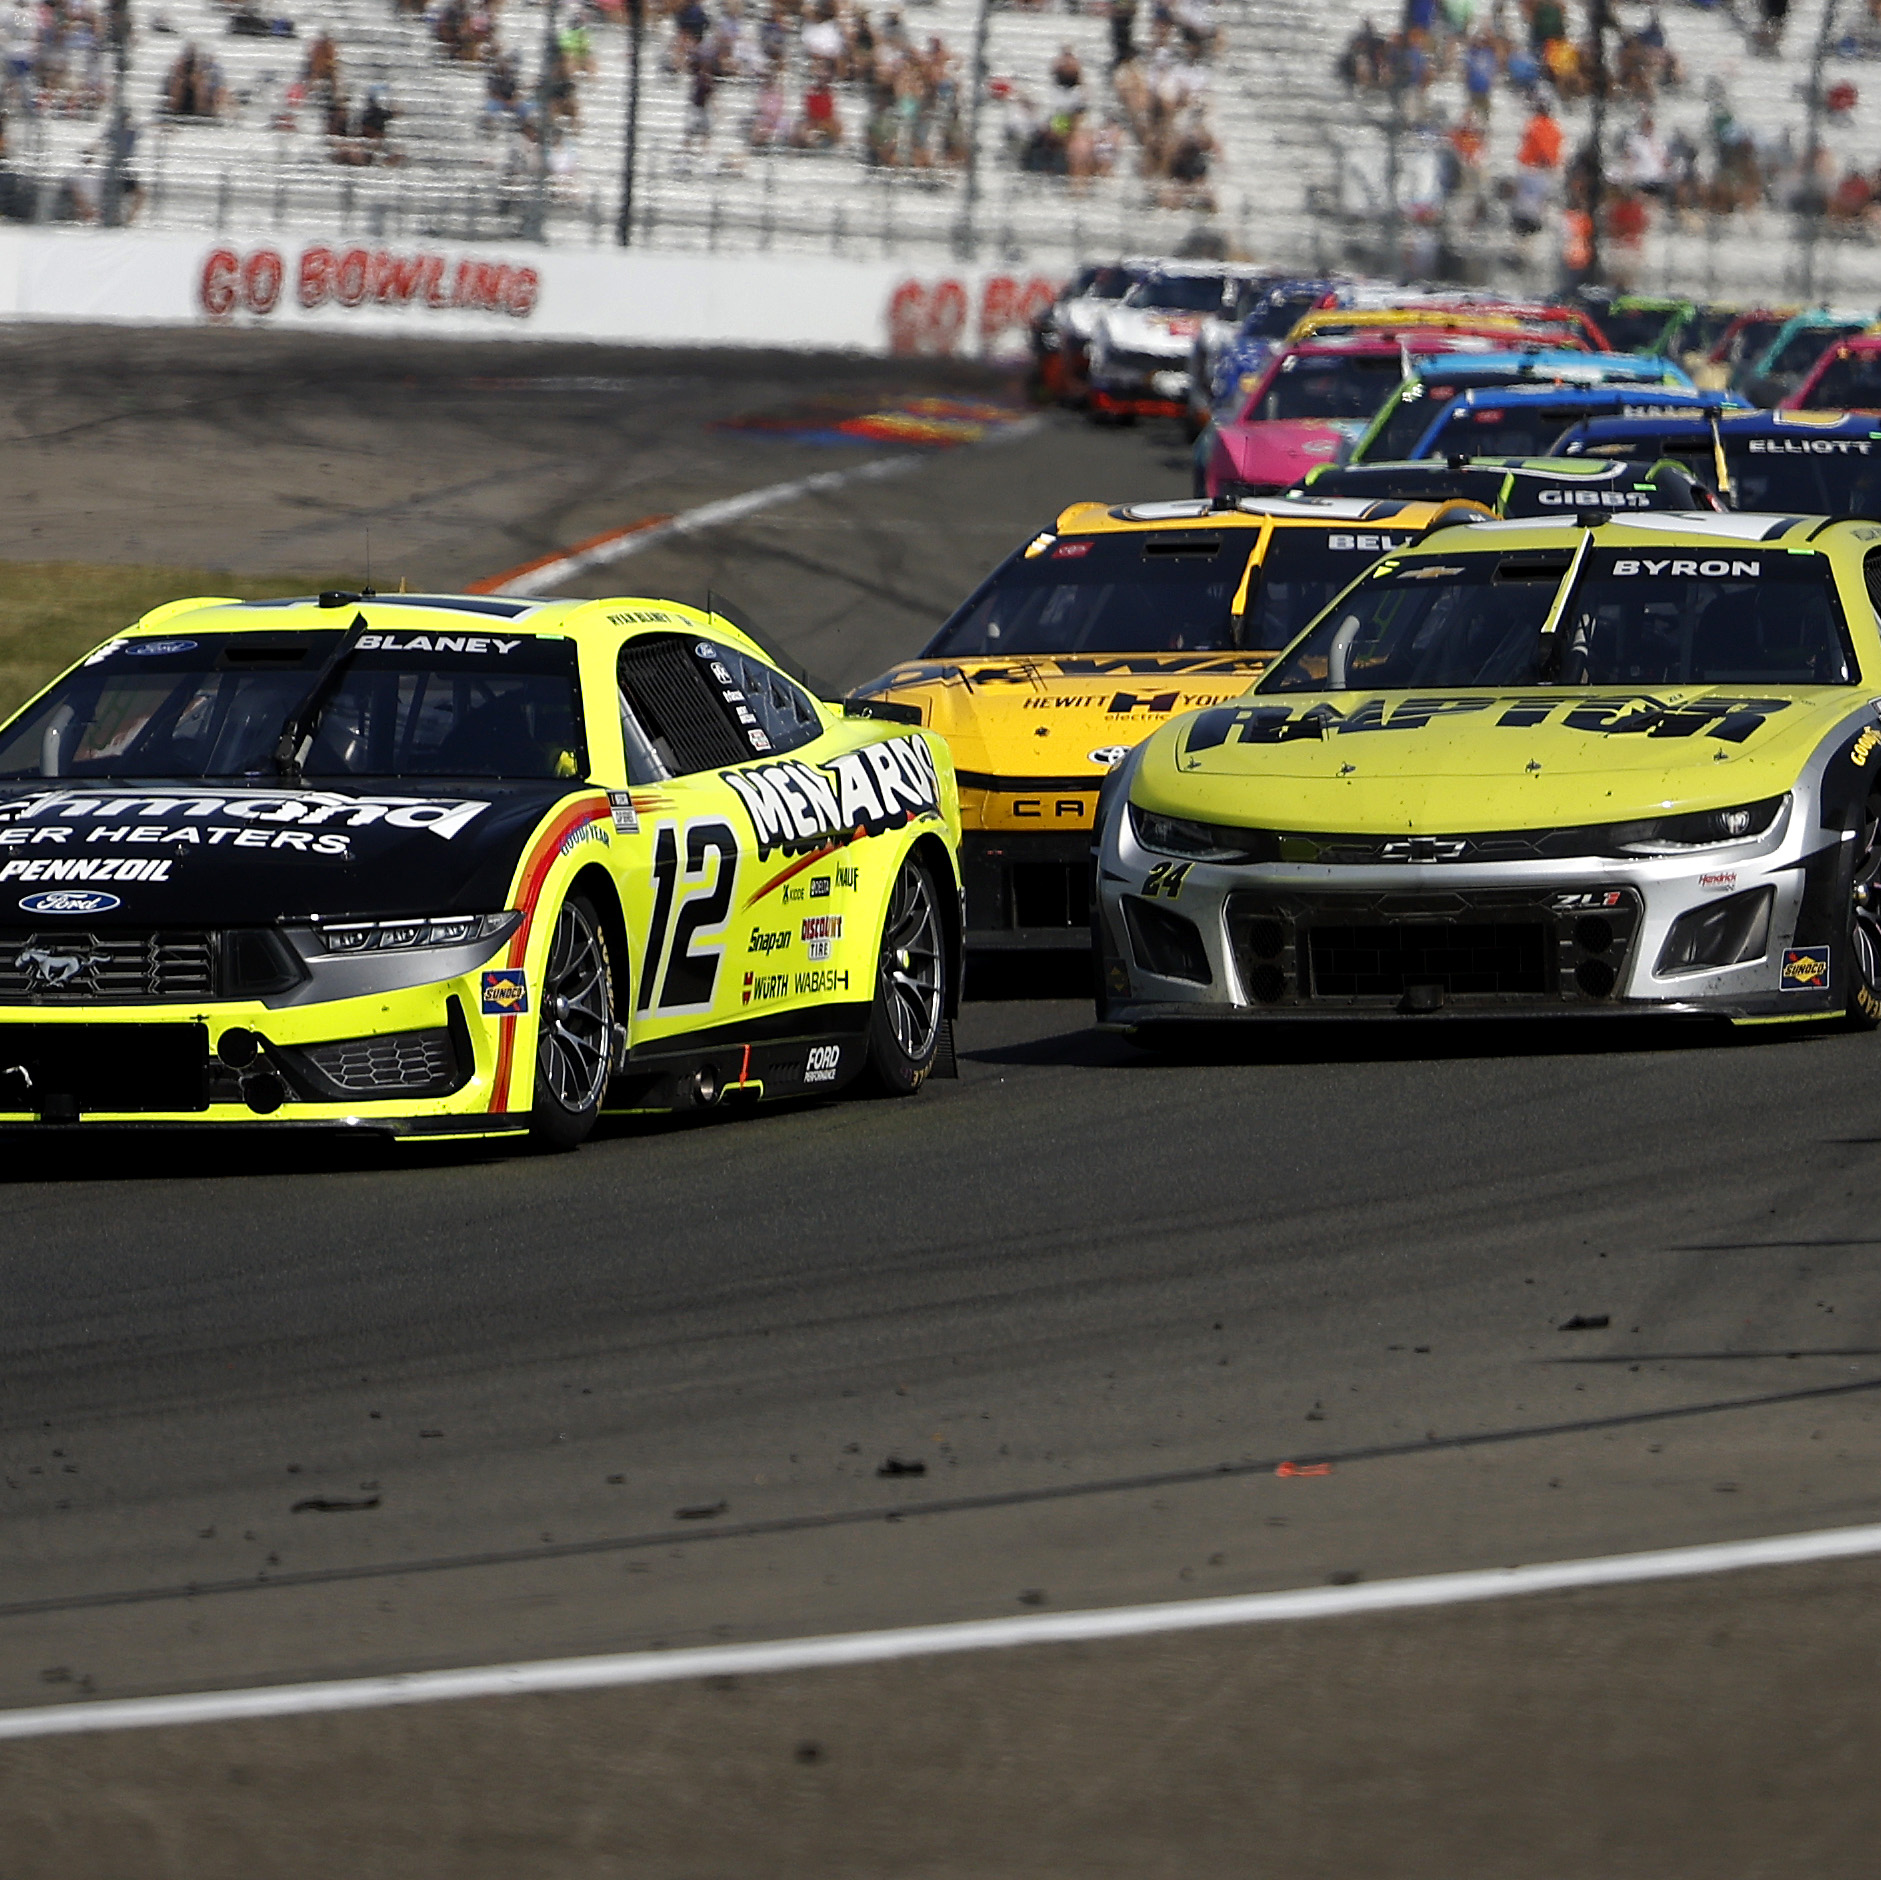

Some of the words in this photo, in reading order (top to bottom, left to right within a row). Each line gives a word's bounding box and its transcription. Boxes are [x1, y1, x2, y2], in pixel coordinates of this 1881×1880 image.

[201, 249, 283, 317] GO
[298, 248, 538, 317] BOWLING
[1748, 439, 1873, 455] ELLIOTT
[1538, 489, 1651, 507] GIBBS
[1613, 559, 1760, 577] BYRON
[355, 635, 522, 654] BLANEY
[1023, 695, 1106, 710] HEWITT
[1182, 694, 1240, 707] YOU
[1185, 696, 1792, 744] RAPTOR
[87, 825, 351, 855] HEATERS
[1141, 861, 1196, 900] 24
[32, 891, 108, 913] Ford
[636, 816, 741, 1019] 12
[801, 916, 843, 941] DISCOUNT
[748, 927, 792, 956] Snap-on
[810, 941, 829, 958] TIRE
[1783, 961, 1826, 977] SUNOCO
[795, 970, 849, 994] WABASH
[484, 987, 526, 1001] SUNOCO
[806, 1045, 840, 1071] FORD
